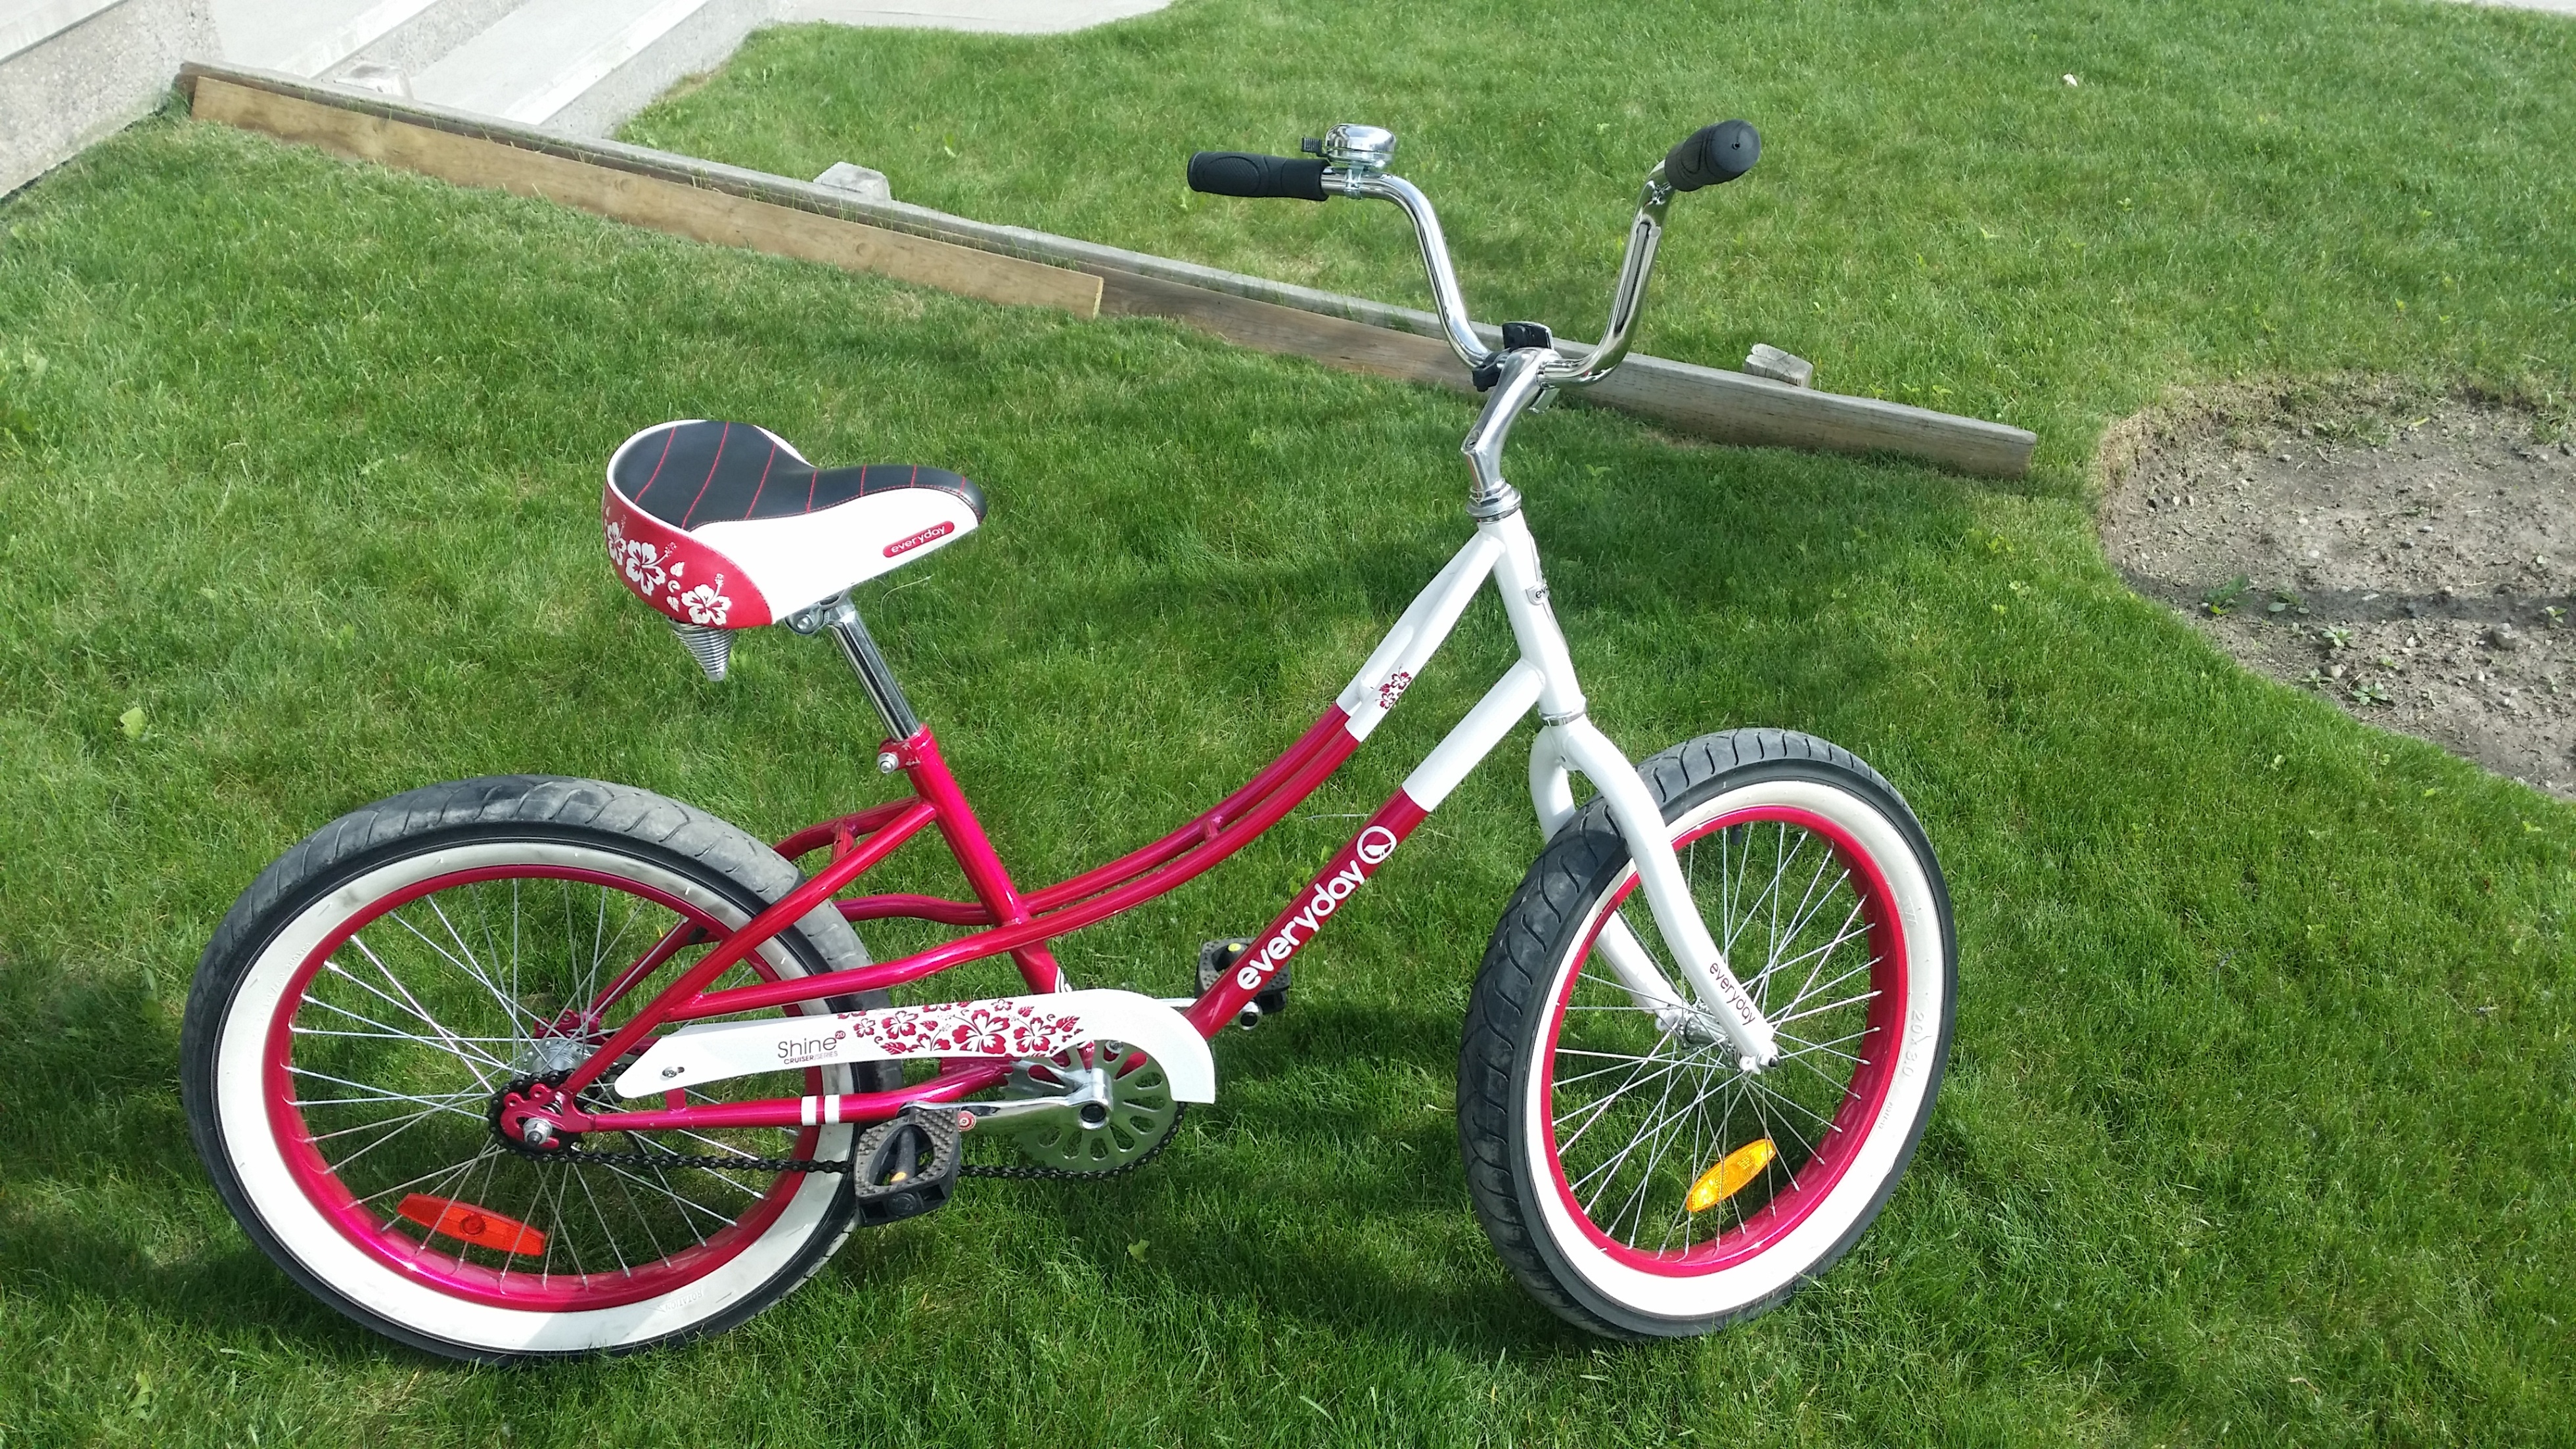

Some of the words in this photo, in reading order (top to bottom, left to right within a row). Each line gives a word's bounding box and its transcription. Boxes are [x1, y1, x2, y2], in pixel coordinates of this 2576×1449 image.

[891, 525, 946, 553] everyday
[1237, 860, 1365, 990] everyday
[1709, 962, 1756, 1026] everyday
[777, 1037, 837, 1059] Shine
[835, 1030, 846, 1039] 20
[666, 1289, 703, 1311] ROTATION
